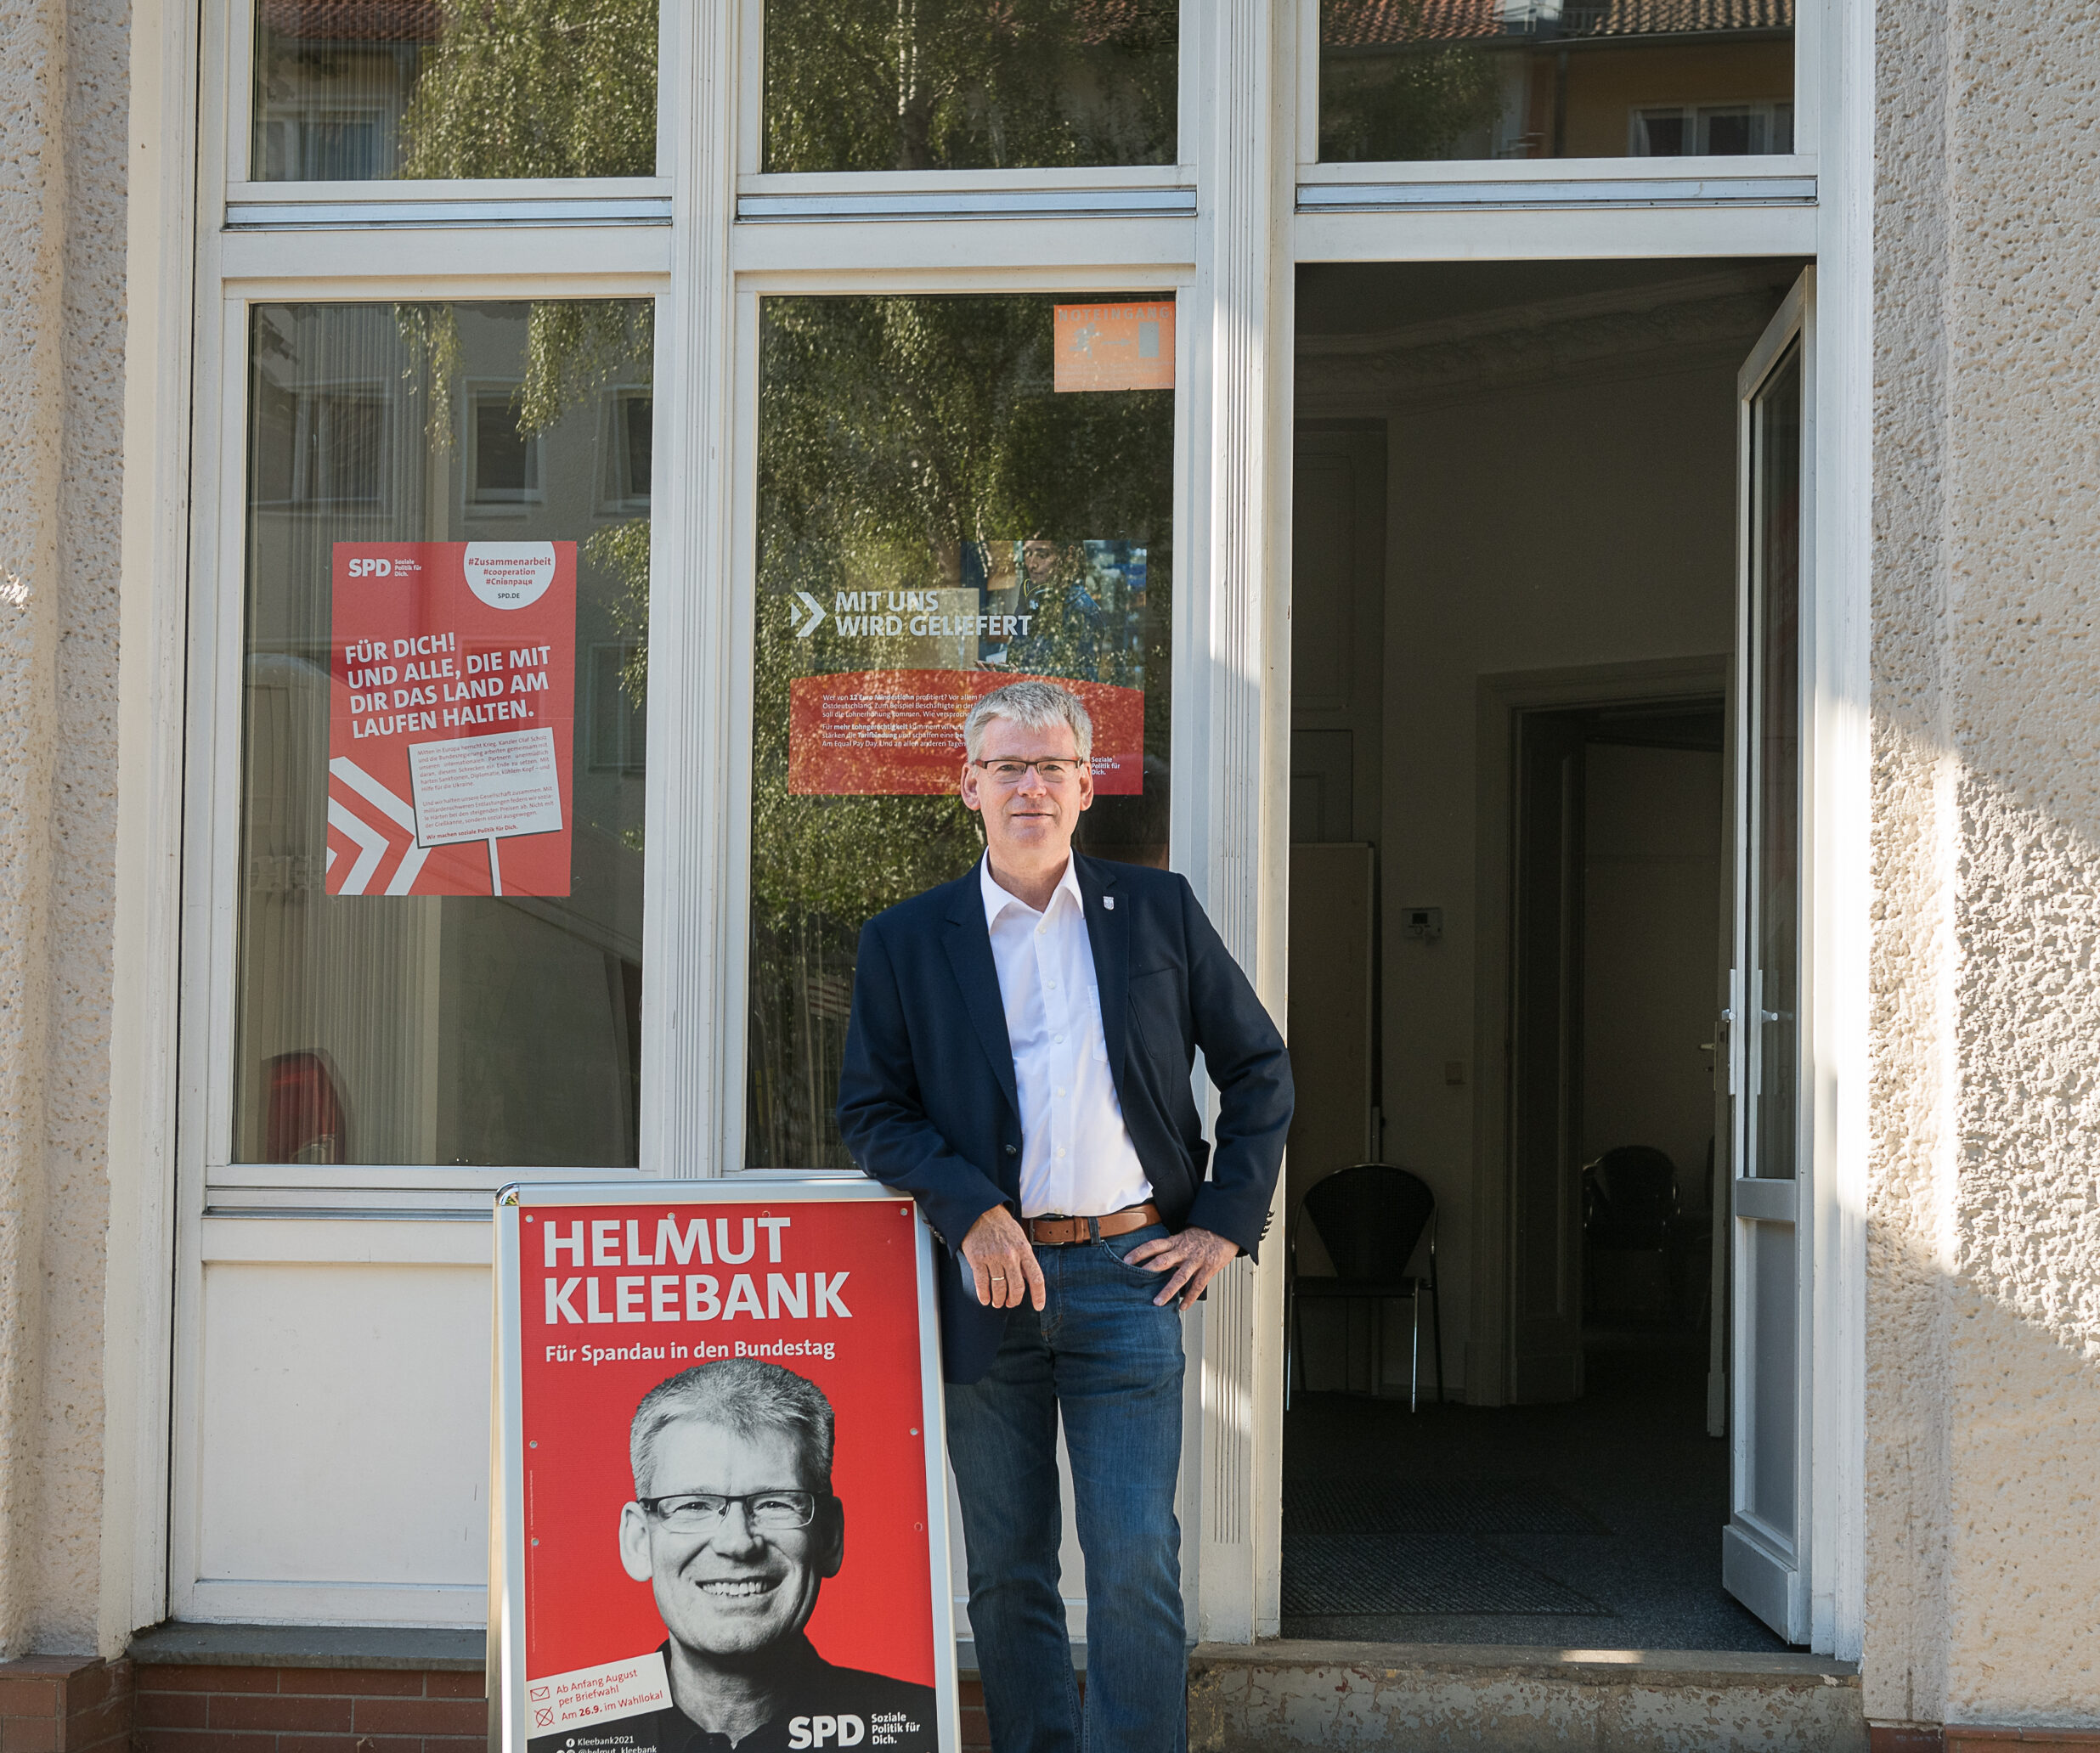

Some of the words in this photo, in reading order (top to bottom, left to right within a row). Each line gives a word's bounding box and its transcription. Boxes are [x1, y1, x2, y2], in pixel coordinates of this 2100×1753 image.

[1058, 306, 1170, 322] NOTEINGANG
[348, 559, 391, 578] SPD
[468, 557, 551, 566] #Zusammenarbeit
[483, 568, 536, 577] #cooperation
[835, 591, 880, 612] MIT
[888, 591, 939, 612] UNS
[836, 616, 903, 636] WIRD
[909, 615, 1032, 636] GELIEFERT
[345, 639, 387, 664] FÜR
[393, 632, 455, 659] DICH!
[347, 667, 398, 689] UND
[404, 658, 460, 682] ALLE,
[466, 651, 504, 674] DIE
[509, 645, 551, 669] MIT
[349, 692, 387, 714] DIR
[393, 685, 438, 708] DAS
[443, 677, 504, 702] LAND
[510, 671, 550, 695] AM
[353, 710, 437, 739] LAUFEN
[443, 699, 534, 728] HALTEN.
[544, 1217, 791, 1268] HELMUT
[545, 1271, 853, 1325] KLEEBANK
[545, 1344, 577, 1362] Für
[581, 1342, 666, 1366] Spandau
[670, 1342, 689, 1359] in
[693, 1341, 727, 1359] den
[734, 1339, 836, 1360] Bundestag
[556, 1685, 568, 1694] Ab
[571, 1677, 604, 1691] Anfang
[606, 1669, 638, 1683] August
[558, 1697, 573, 1708] per
[576, 1685, 619, 1701] Briefwahl
[562, 1711, 578, 1722] Am
[579, 1705, 603, 1716] 26.9.
[604, 1703, 617, 1711] im
[618, 1690, 663, 1709] Wahllokal
[871, 1711, 906, 1723] Soziale
[872, 1722, 903, 1734] Politik
[906, 1722, 921, 1733] für
[577, 1735, 634, 1746] Kleebank2021
[788, 1714, 865, 1750] SPD
[872, 1734, 897, 1745] Dich.
[579, 1745, 658, 1753] @helmutkleebank
